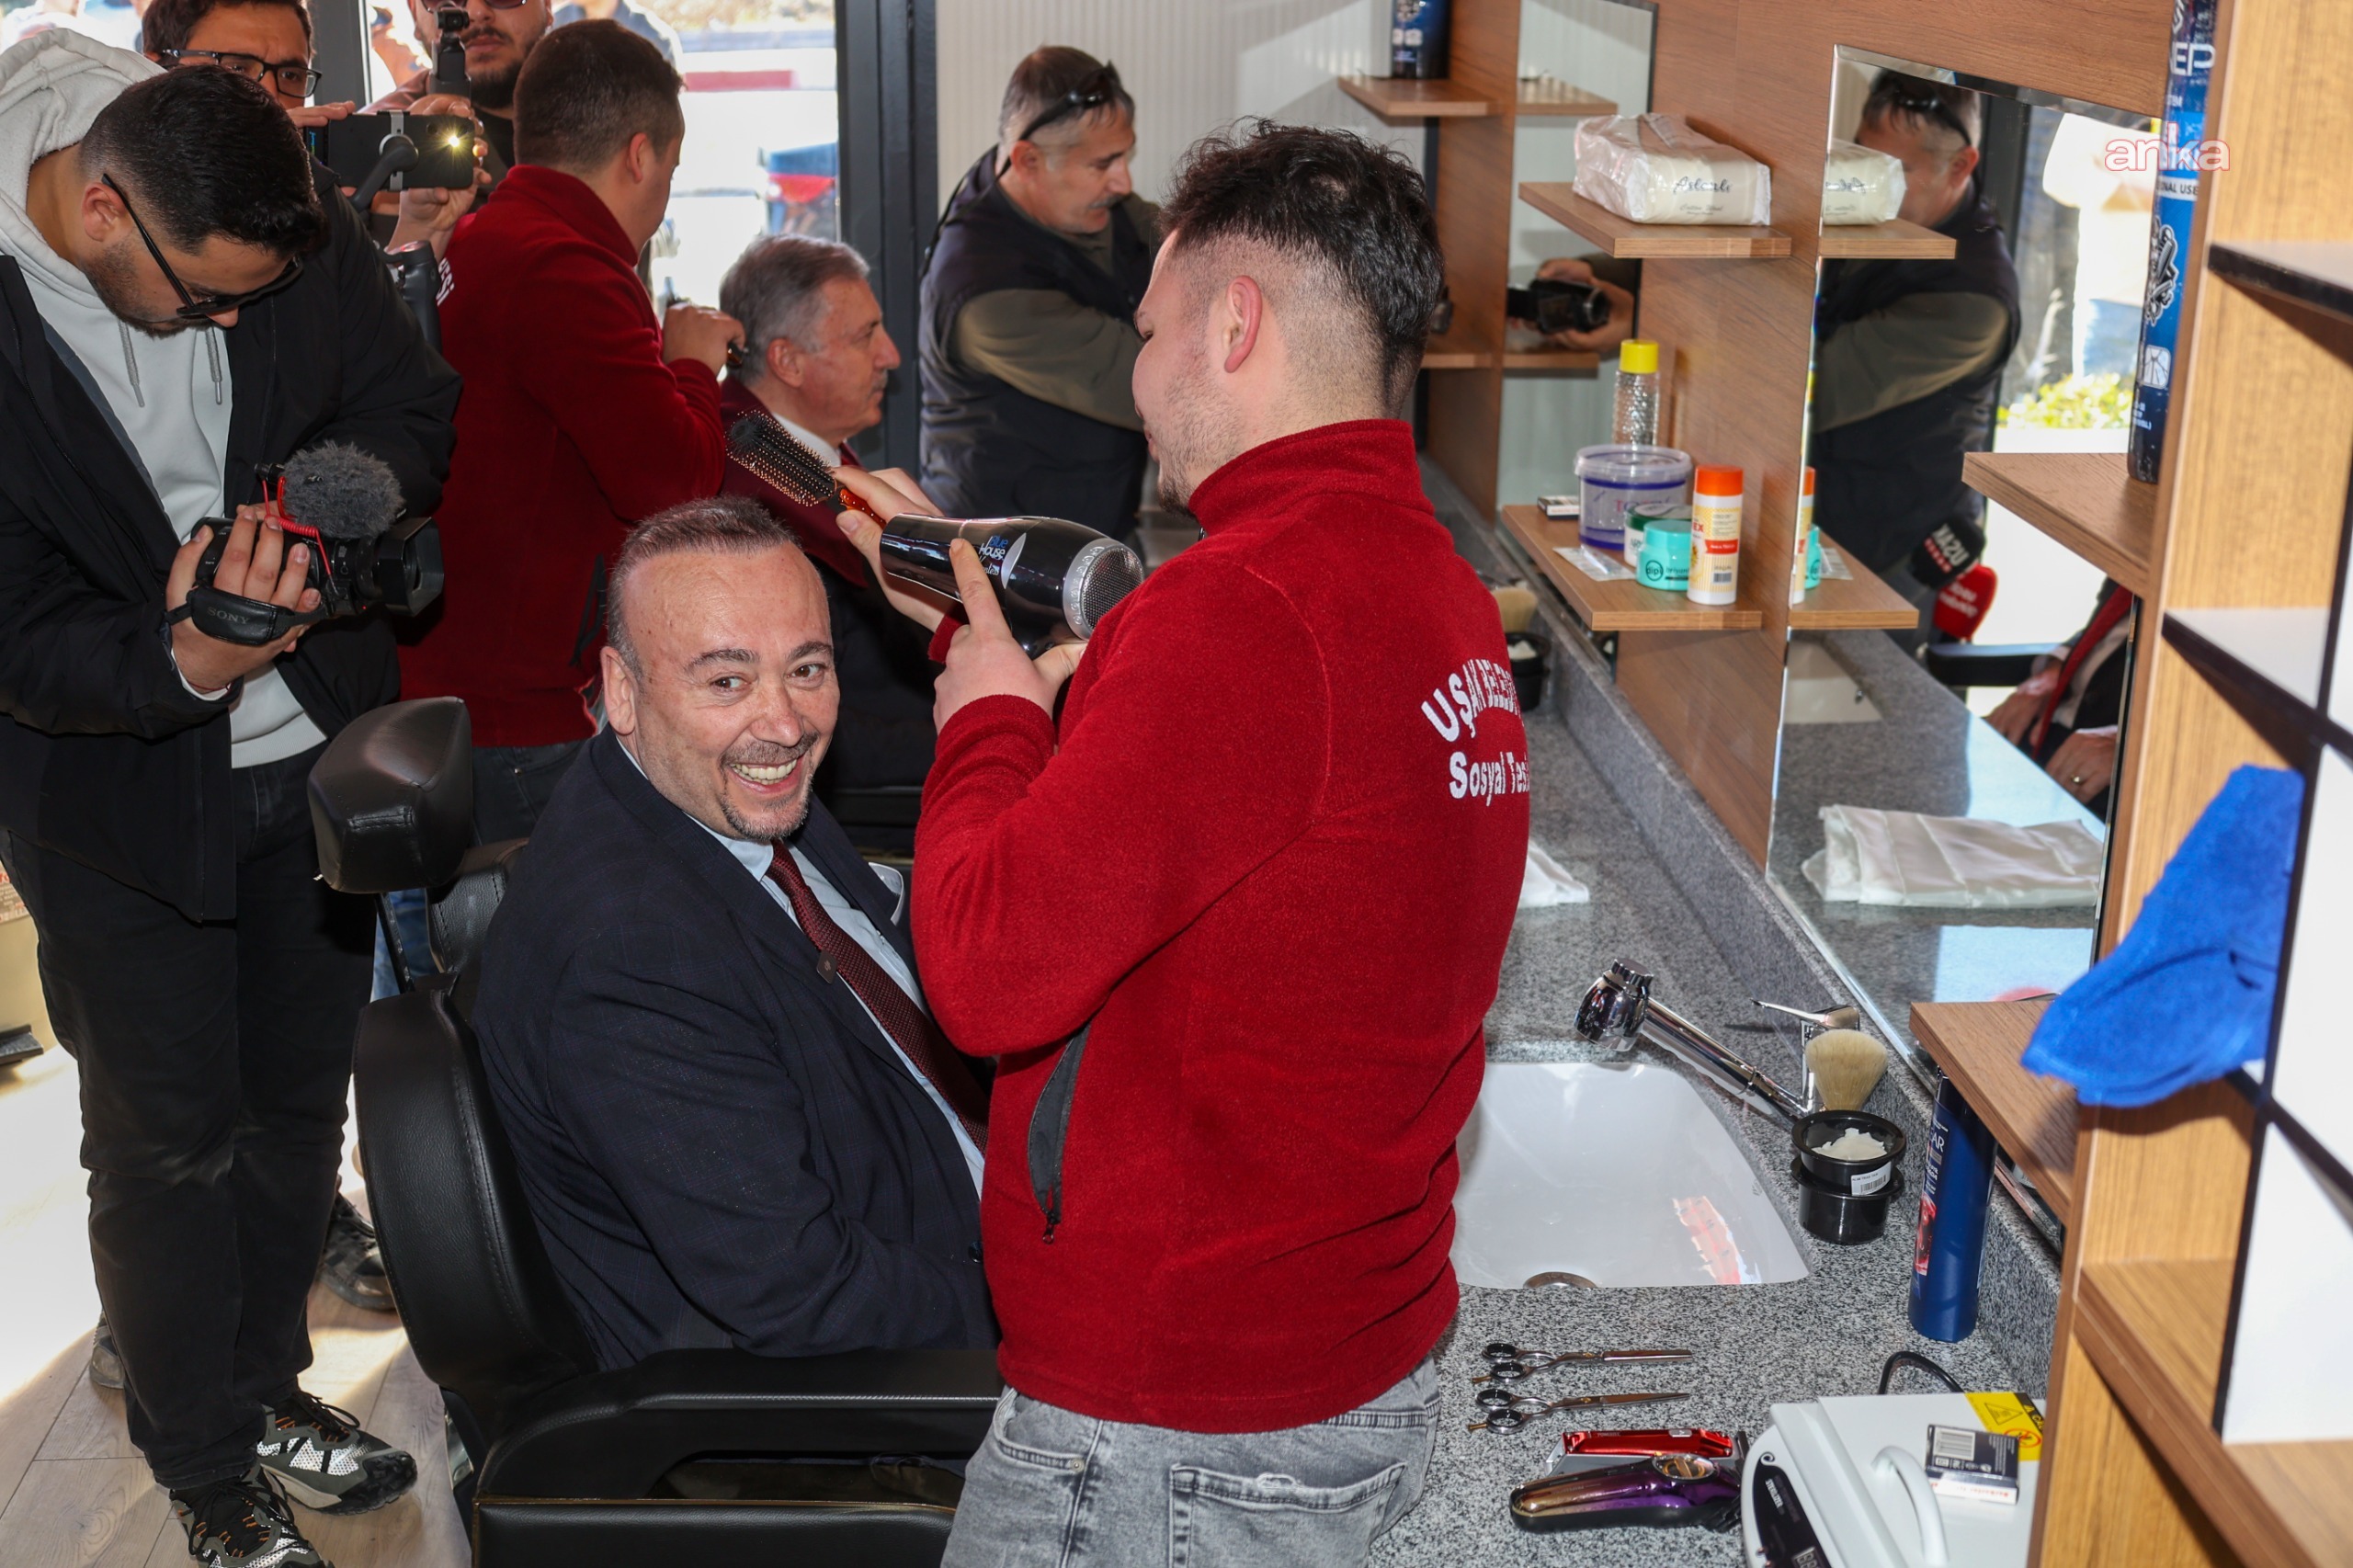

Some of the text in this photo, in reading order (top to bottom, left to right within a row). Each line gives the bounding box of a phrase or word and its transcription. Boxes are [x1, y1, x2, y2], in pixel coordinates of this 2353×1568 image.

[2179, 183, 2200, 196] USE
[978, 536, 1006, 561] House
[989, 535, 1008, 549] Blue
[207, 606, 250, 625] SONY
[1421, 658, 1487, 743] UŞAK
[1449, 751, 1529, 807] Sosyal Tes
[1765, 1477, 1784, 1508] STERILIZER
